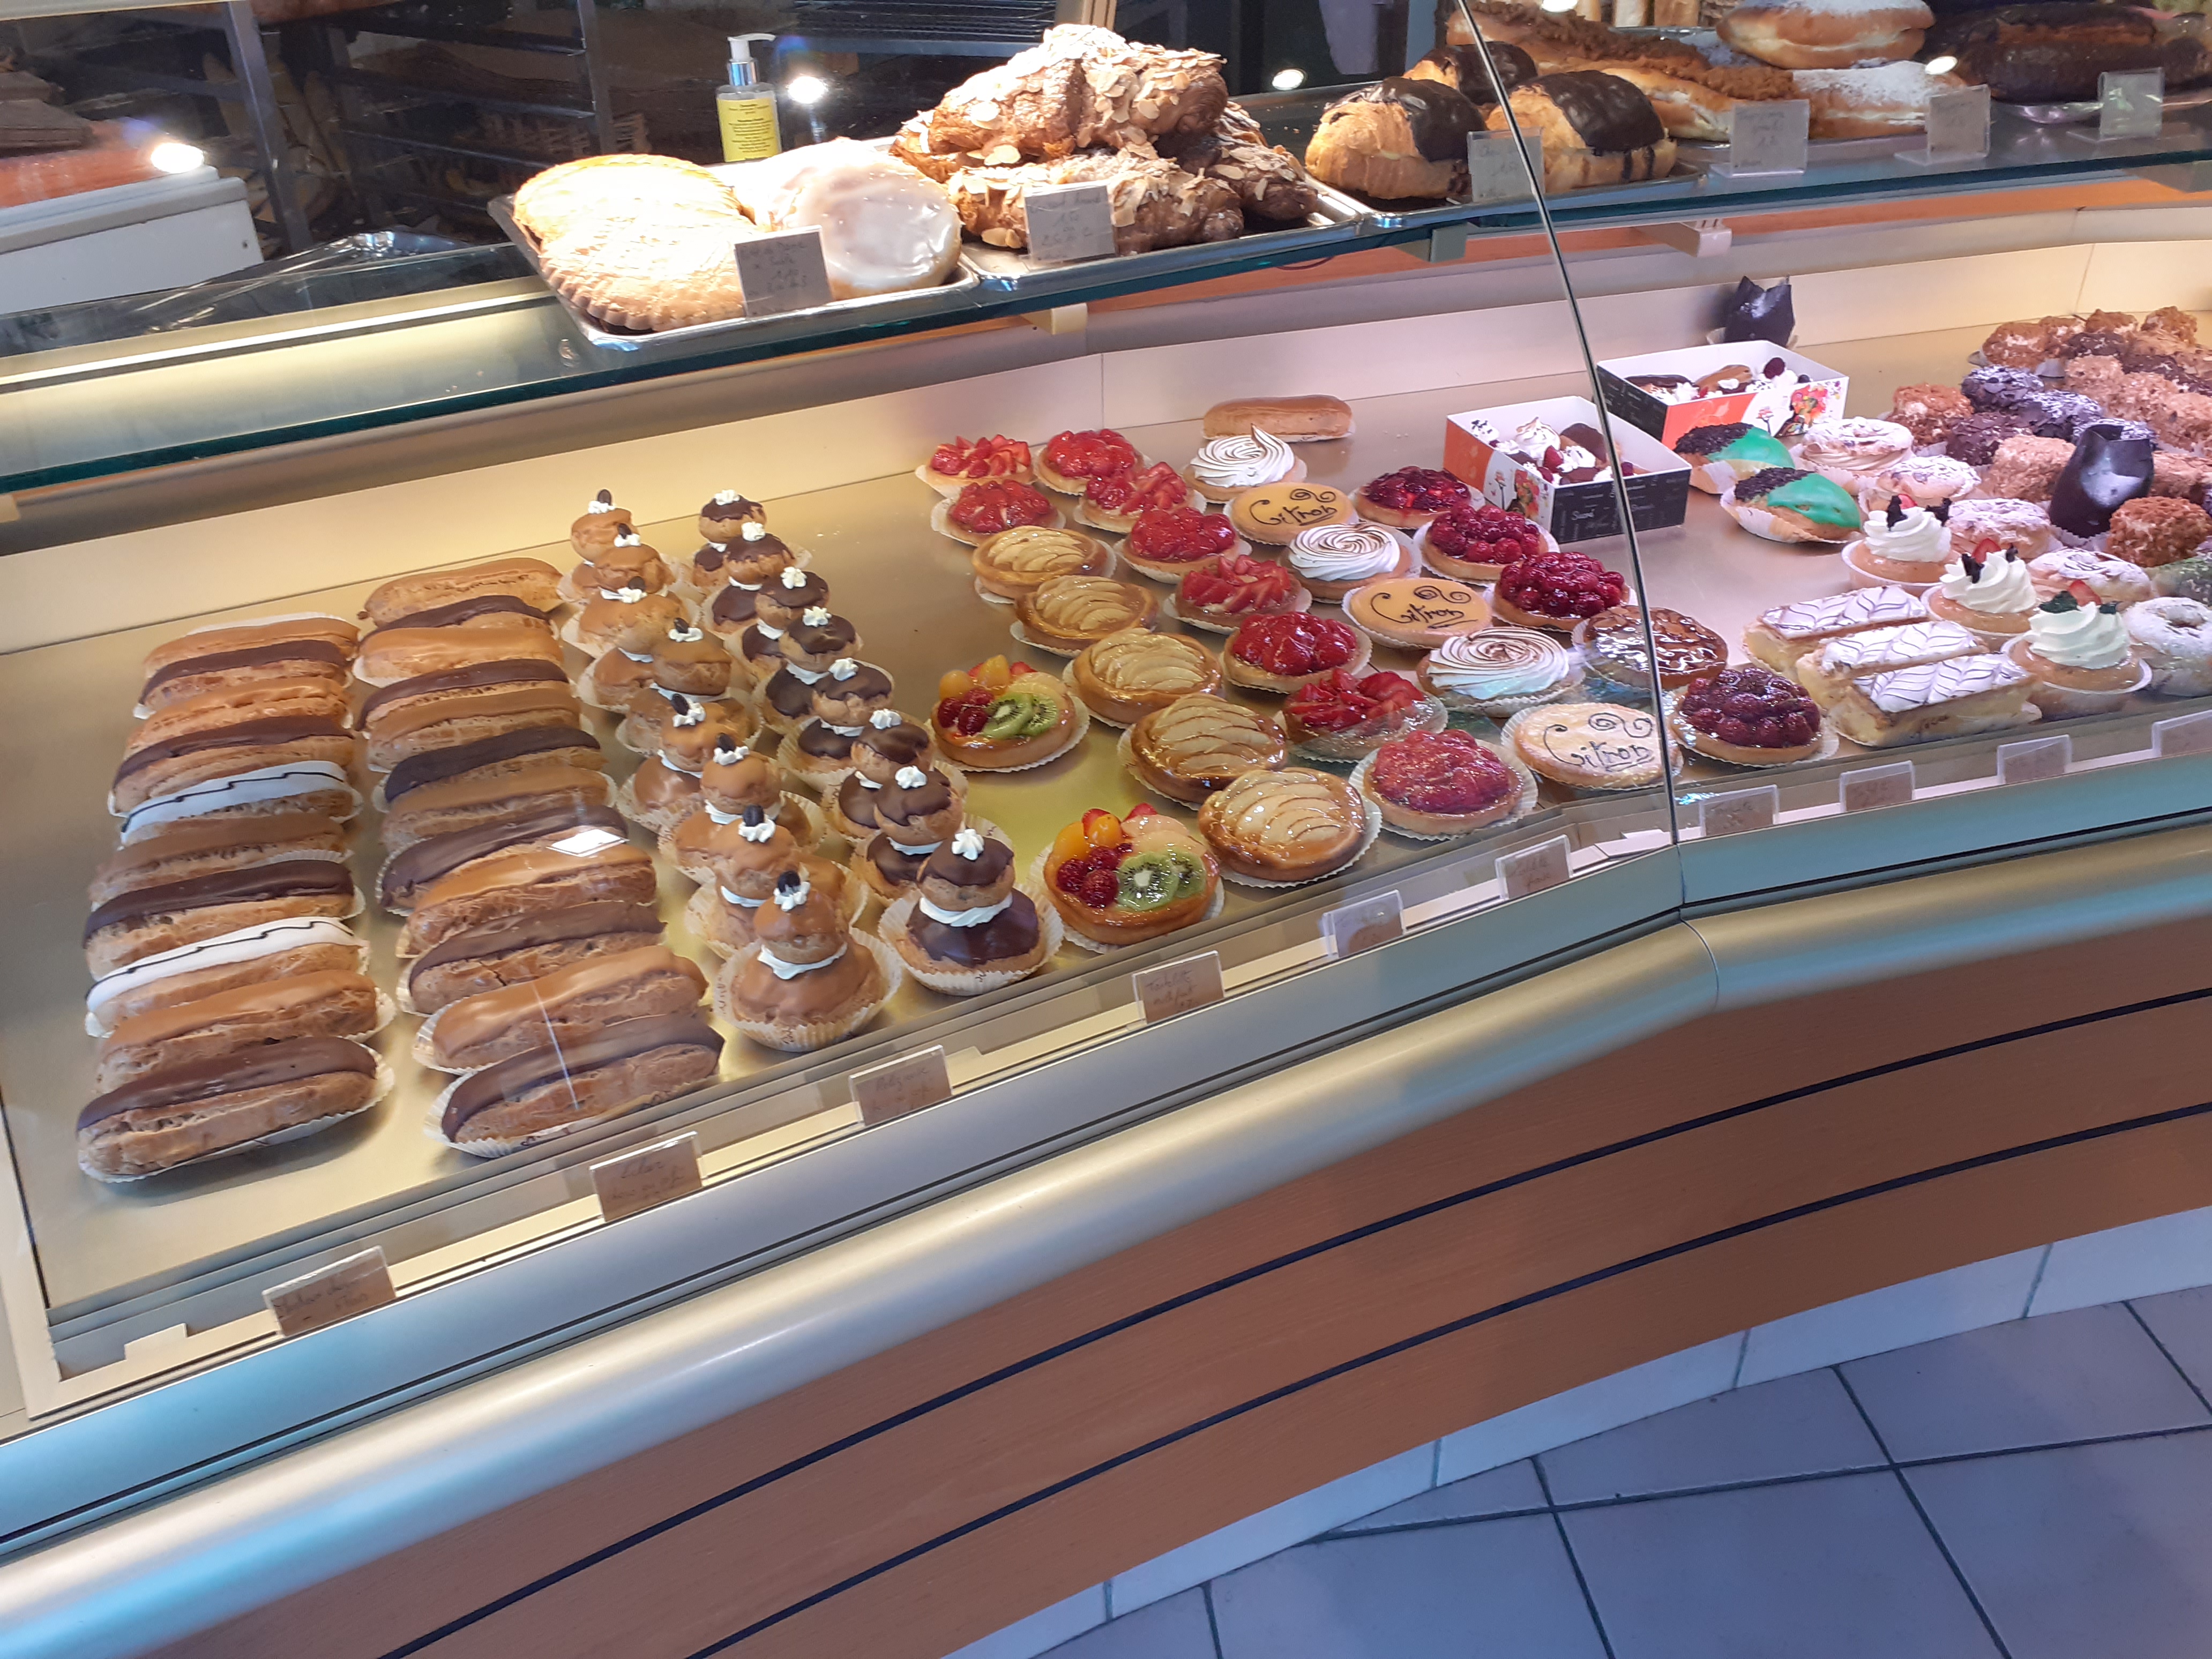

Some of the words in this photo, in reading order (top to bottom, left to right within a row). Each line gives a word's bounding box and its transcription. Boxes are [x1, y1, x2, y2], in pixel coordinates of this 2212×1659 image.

[1250, 499, 1337, 526] Citron
[1370, 593, 1465, 628] Citron
[1543, 724, 1654, 771] Citron
